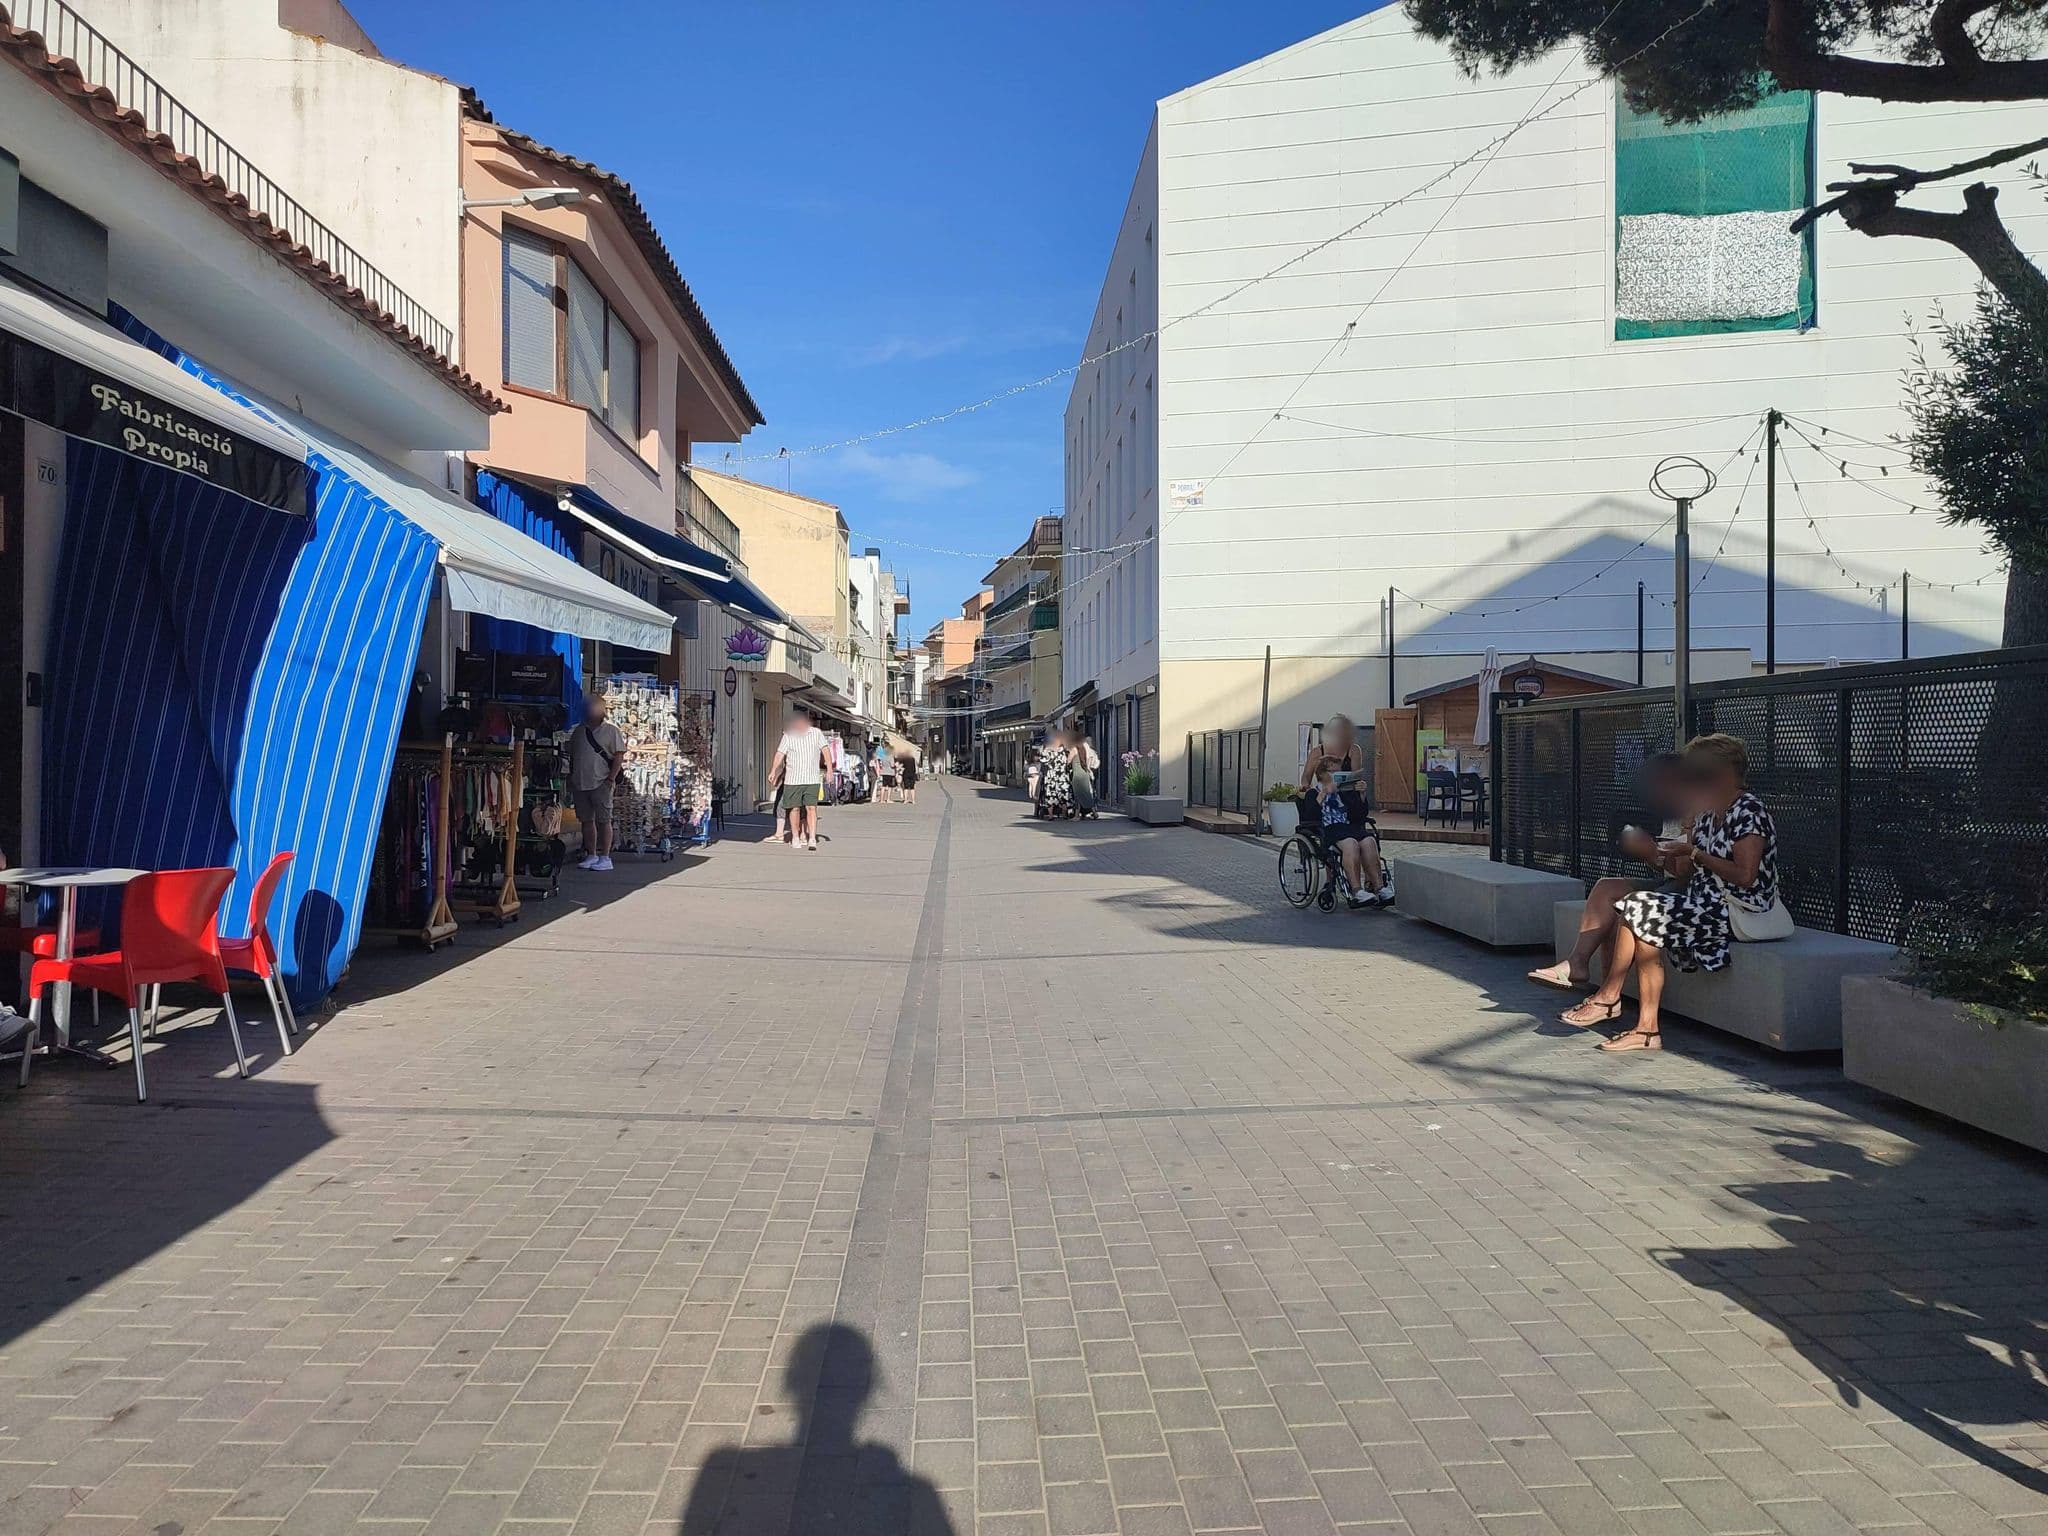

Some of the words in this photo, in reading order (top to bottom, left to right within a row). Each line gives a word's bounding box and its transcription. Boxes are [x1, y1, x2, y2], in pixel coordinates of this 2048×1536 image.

[91, 384, 232, 455] Fabricació
[40, 465, 55, 482] 70
[123, 427, 209, 475] Propia
